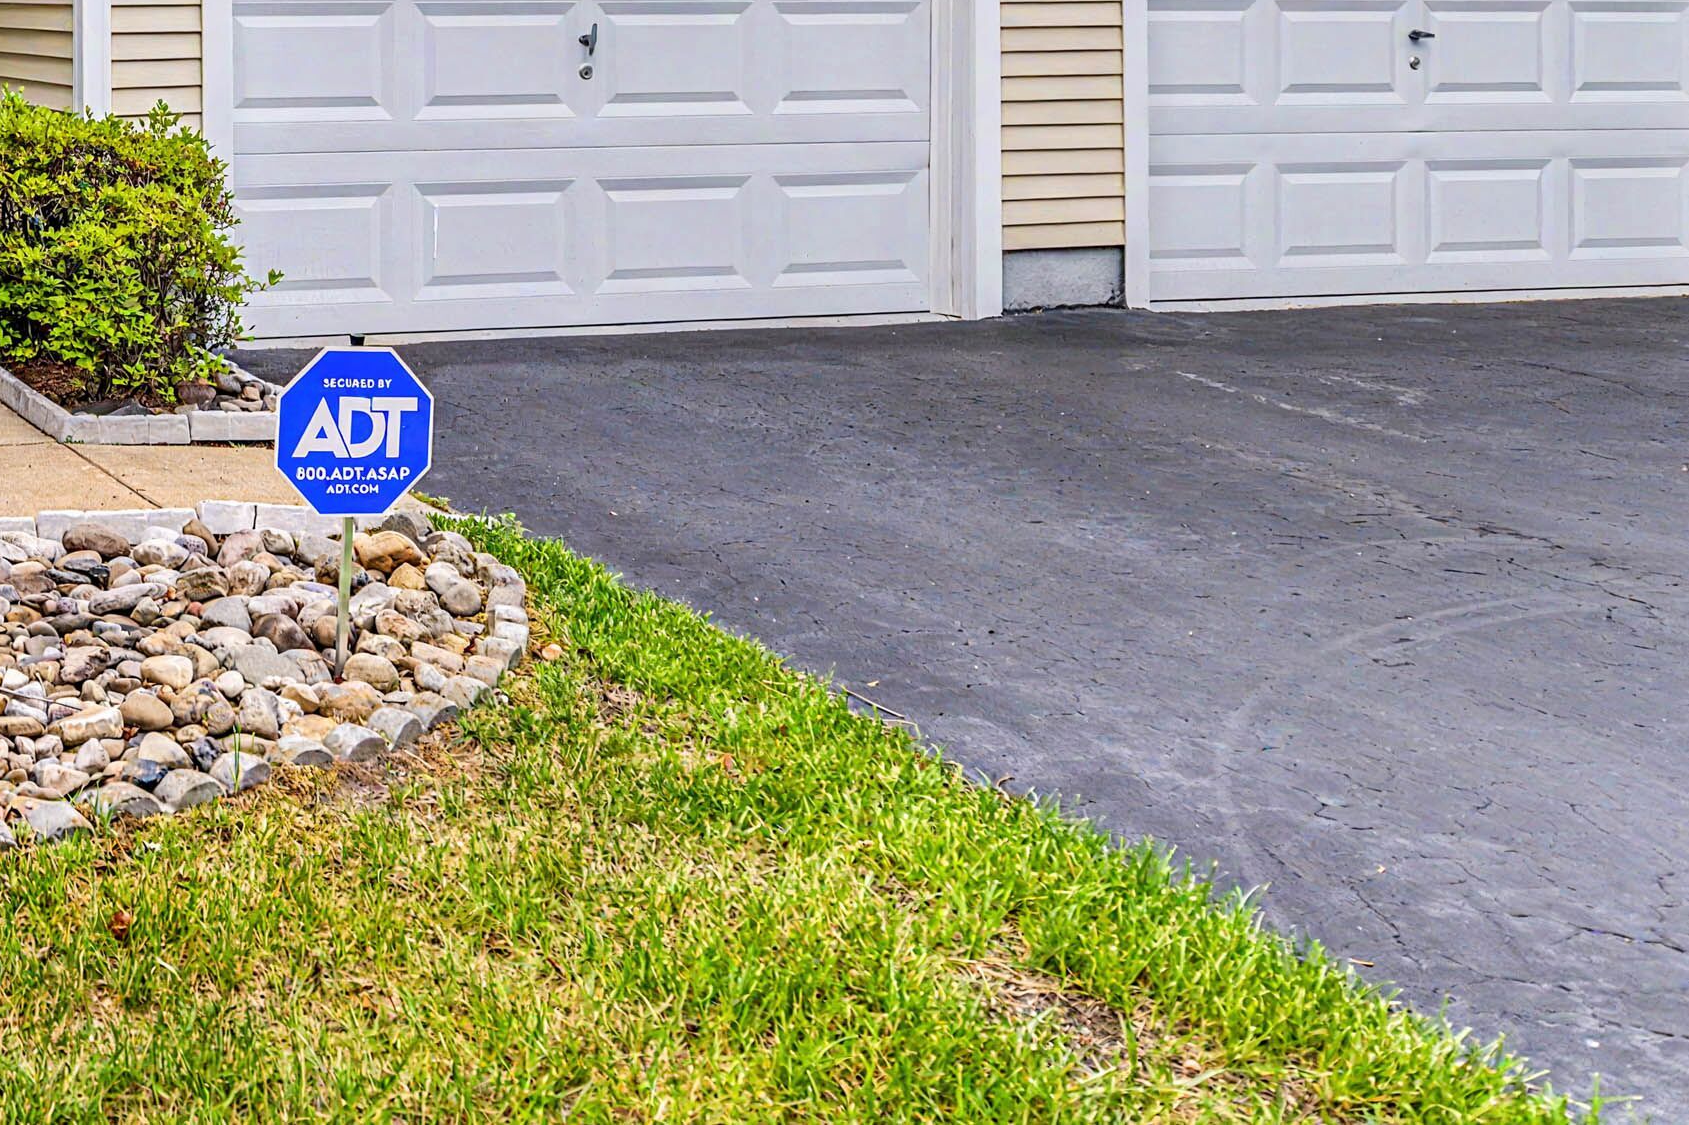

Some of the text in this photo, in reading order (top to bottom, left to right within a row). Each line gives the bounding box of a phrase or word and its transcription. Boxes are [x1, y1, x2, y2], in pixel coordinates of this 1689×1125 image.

[323, 378, 393, 389] SECURED BY
[291, 396, 418, 459] ADT
[296, 466, 411, 481] 800.ADT.ASAP
[326, 484, 380, 495] ADT.COM
